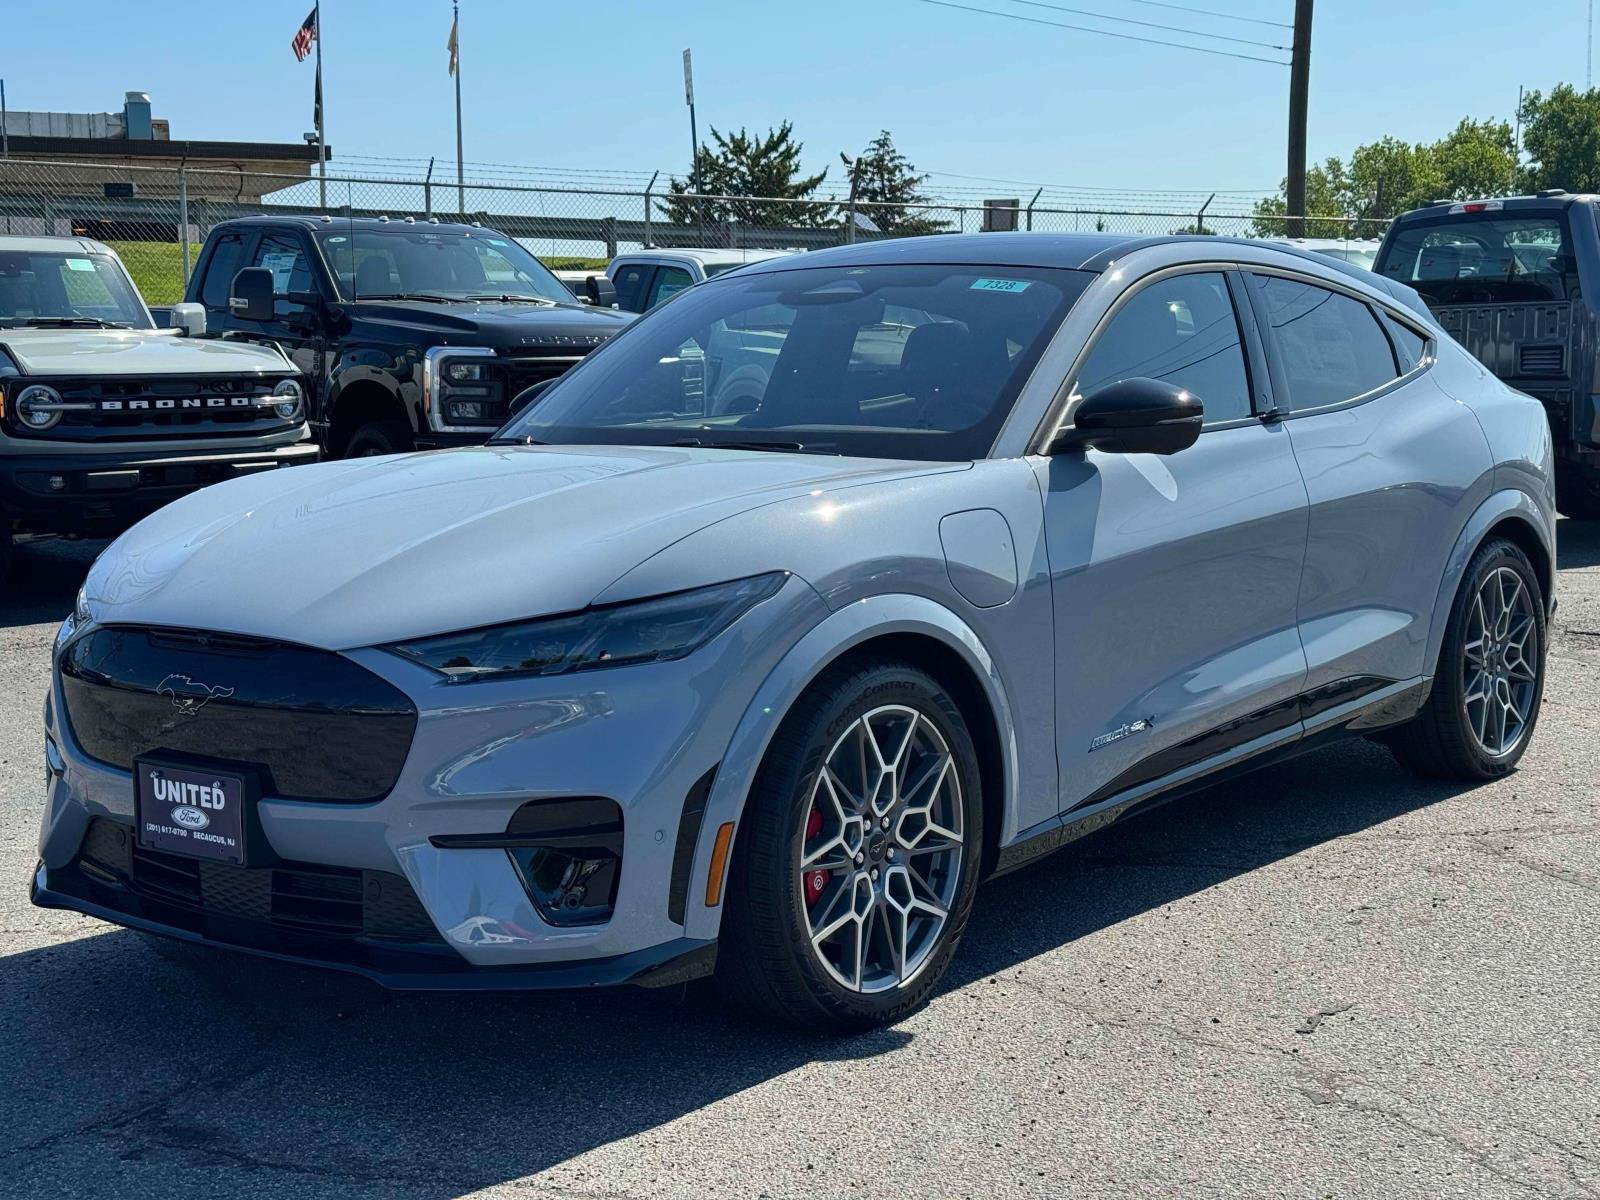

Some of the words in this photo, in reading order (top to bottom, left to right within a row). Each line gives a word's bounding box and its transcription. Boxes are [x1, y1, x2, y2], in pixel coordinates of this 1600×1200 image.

[983, 280, 1017, 290] 7328
[101, 398, 249, 411] BRONCO
[153, 777, 225, 810] UNITED
[146, 822, 161, 833] (201)
[227, 838, 235, 847] NJ
